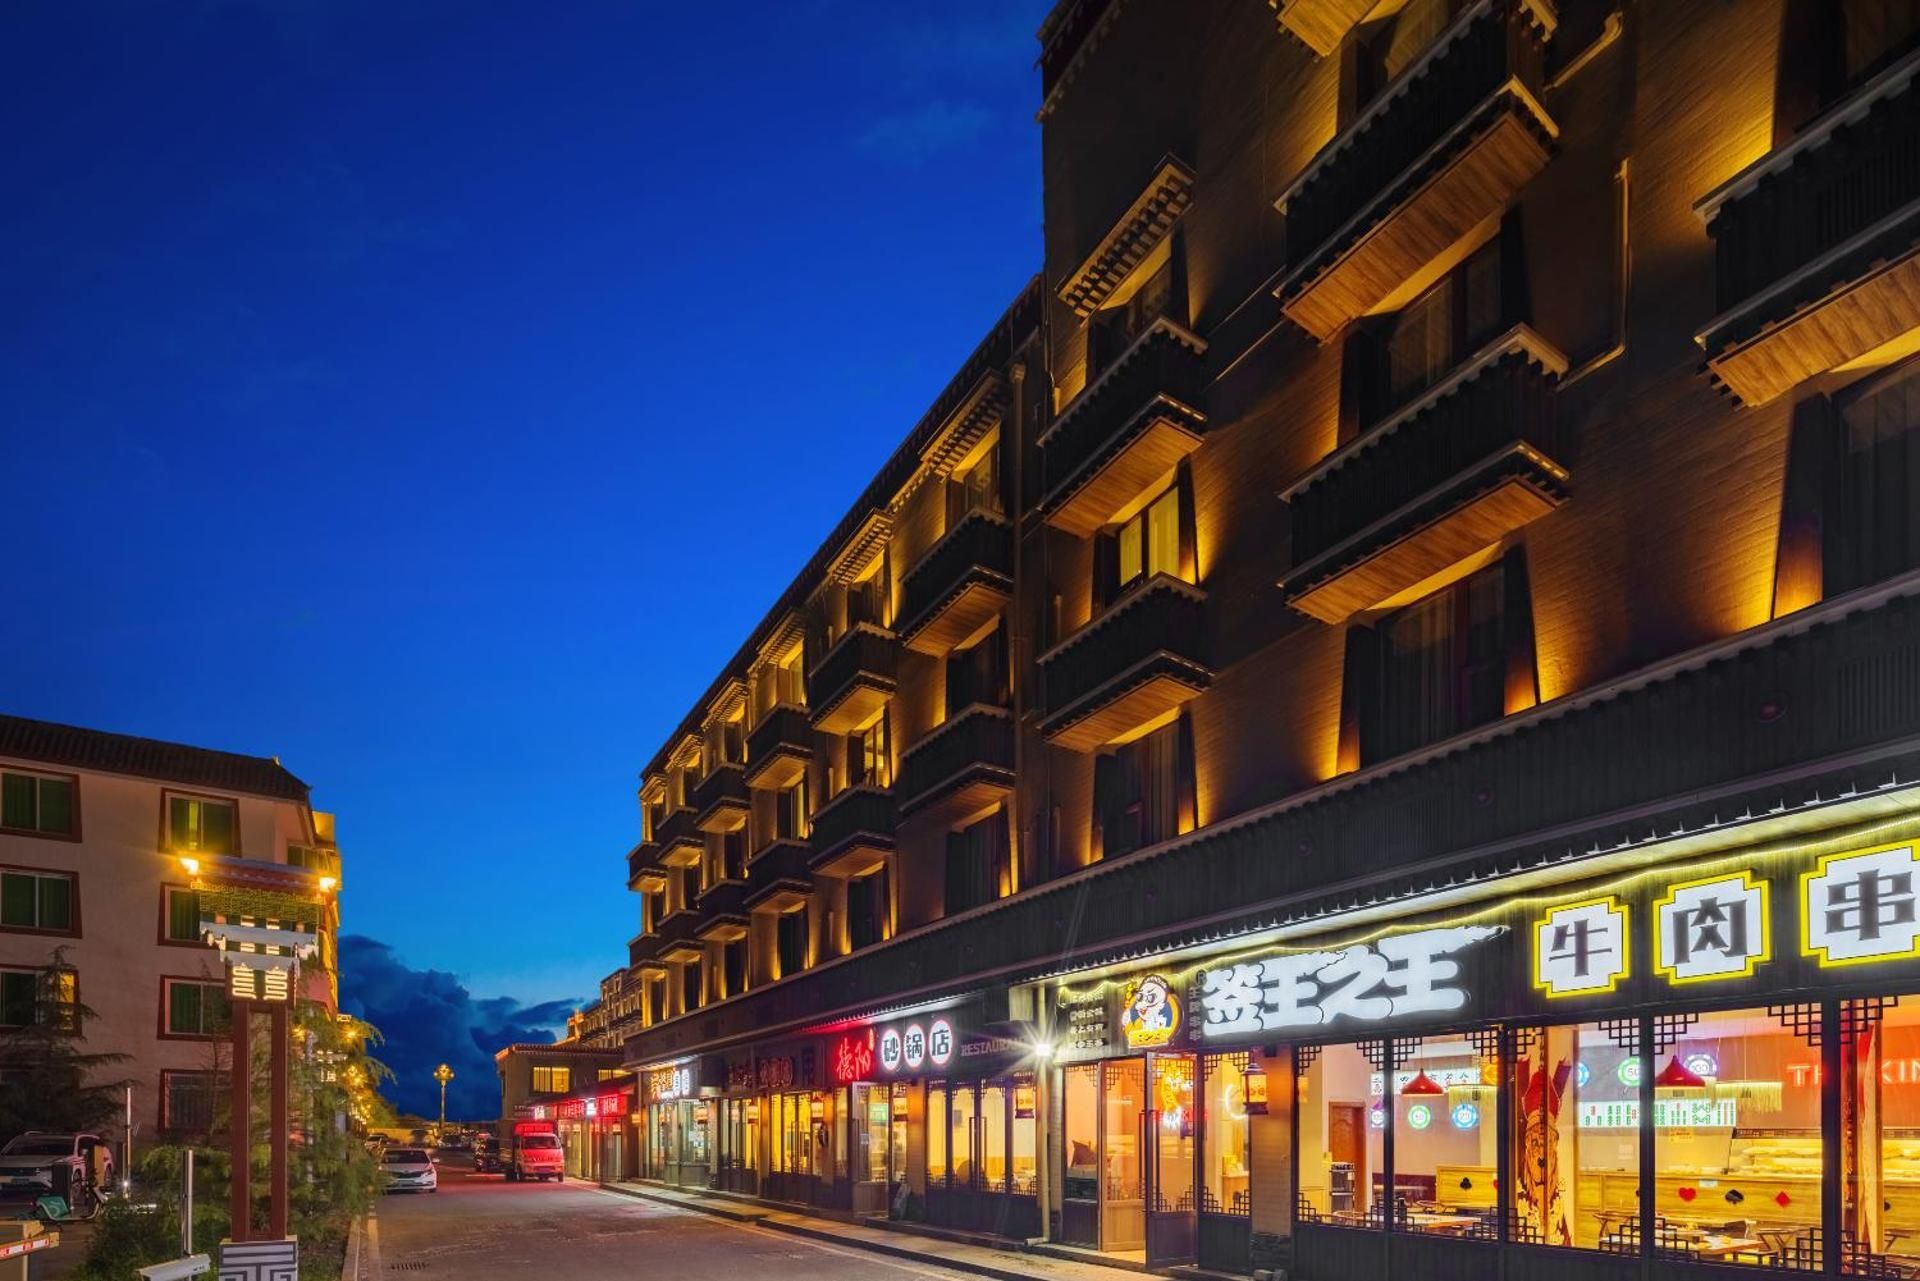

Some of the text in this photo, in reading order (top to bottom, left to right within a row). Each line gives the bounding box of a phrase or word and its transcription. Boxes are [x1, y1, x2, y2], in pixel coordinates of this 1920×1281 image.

[1549, 869, 1916, 977] 牛肉串
[883, 1030, 950, 1062] 砂锅店
